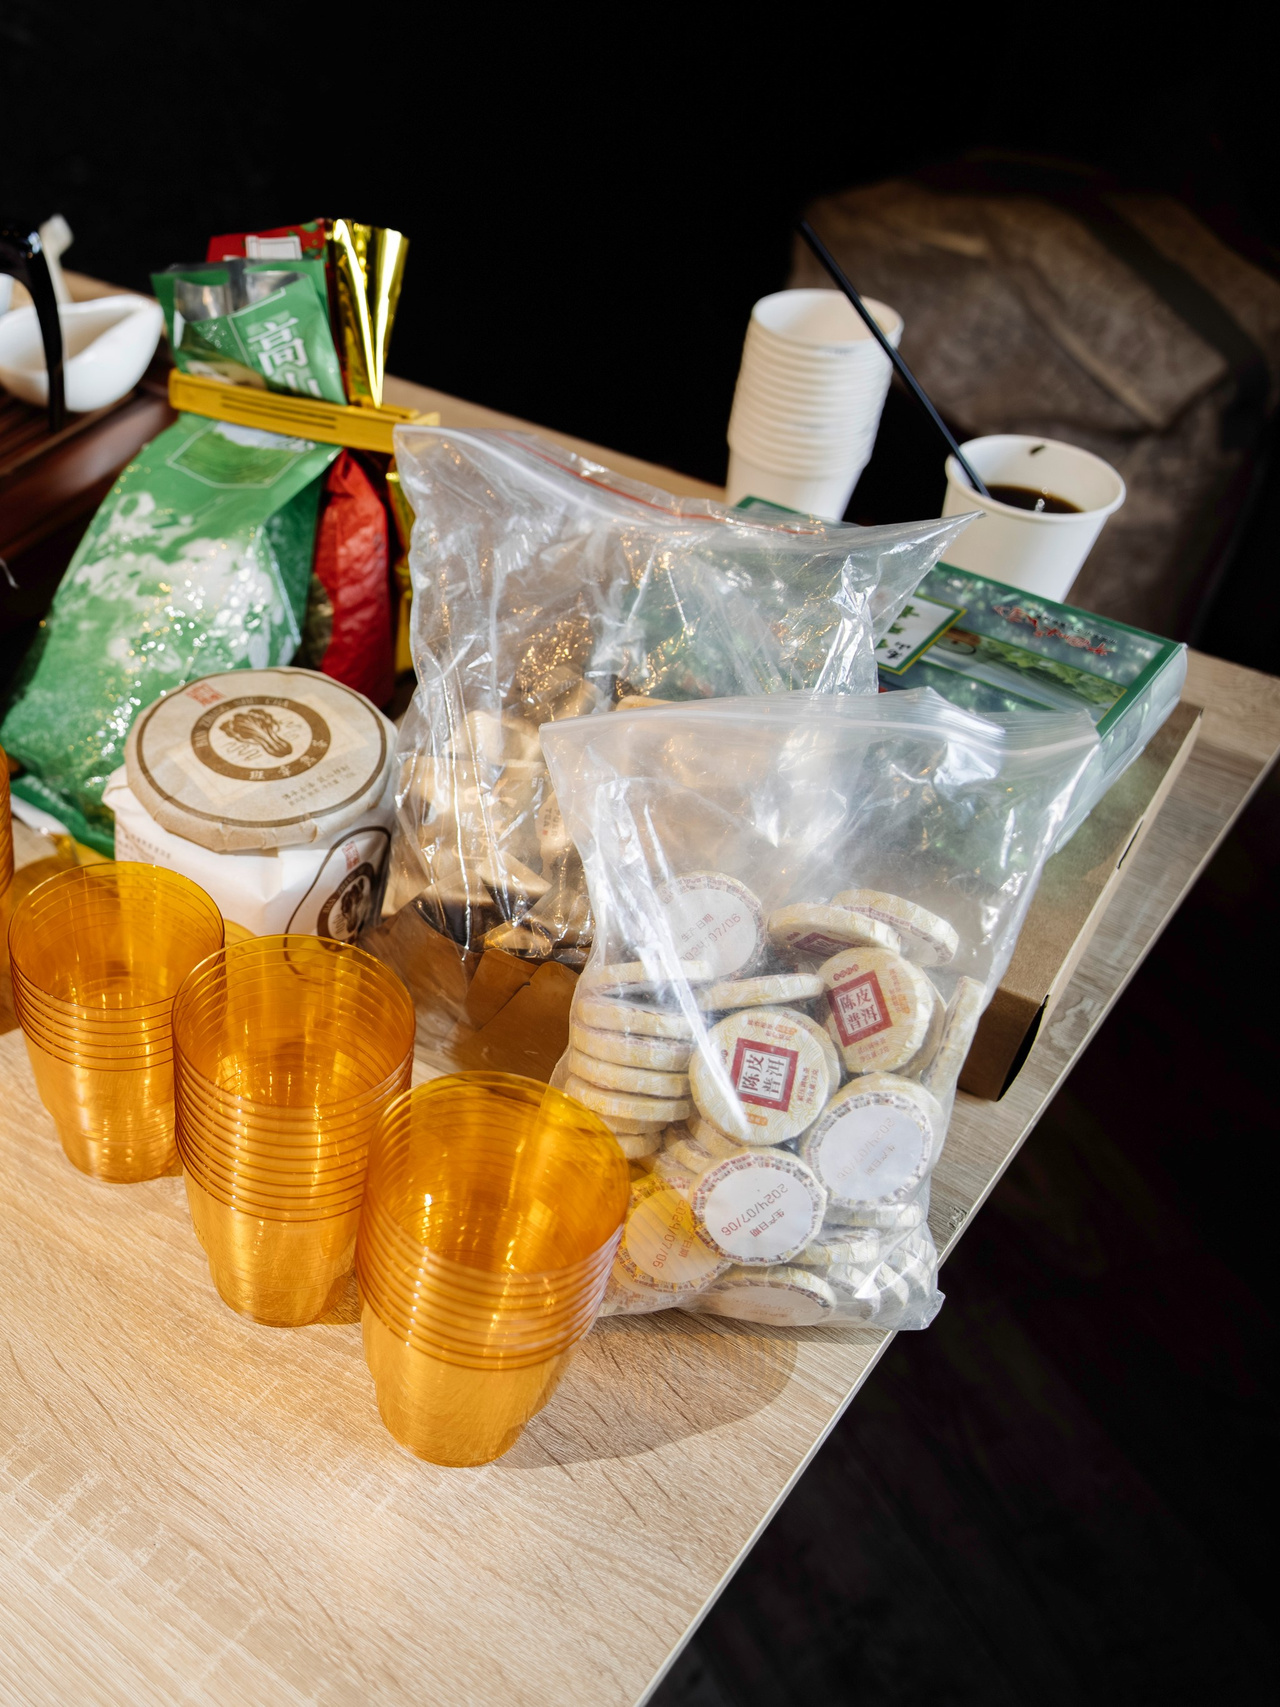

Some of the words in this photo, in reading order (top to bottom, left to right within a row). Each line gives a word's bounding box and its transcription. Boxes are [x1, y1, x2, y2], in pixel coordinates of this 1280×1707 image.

[840, 987, 872, 1014] 陈皮
[846, 1004, 878, 1031] 普洱
[741, 1054, 765, 1092] 陈皮
[761, 1057, 785, 1094] 普洱
[720, 1183, 789, 1236] 2024/07/06
[749, 1208, 785, 1238] 生产日期
